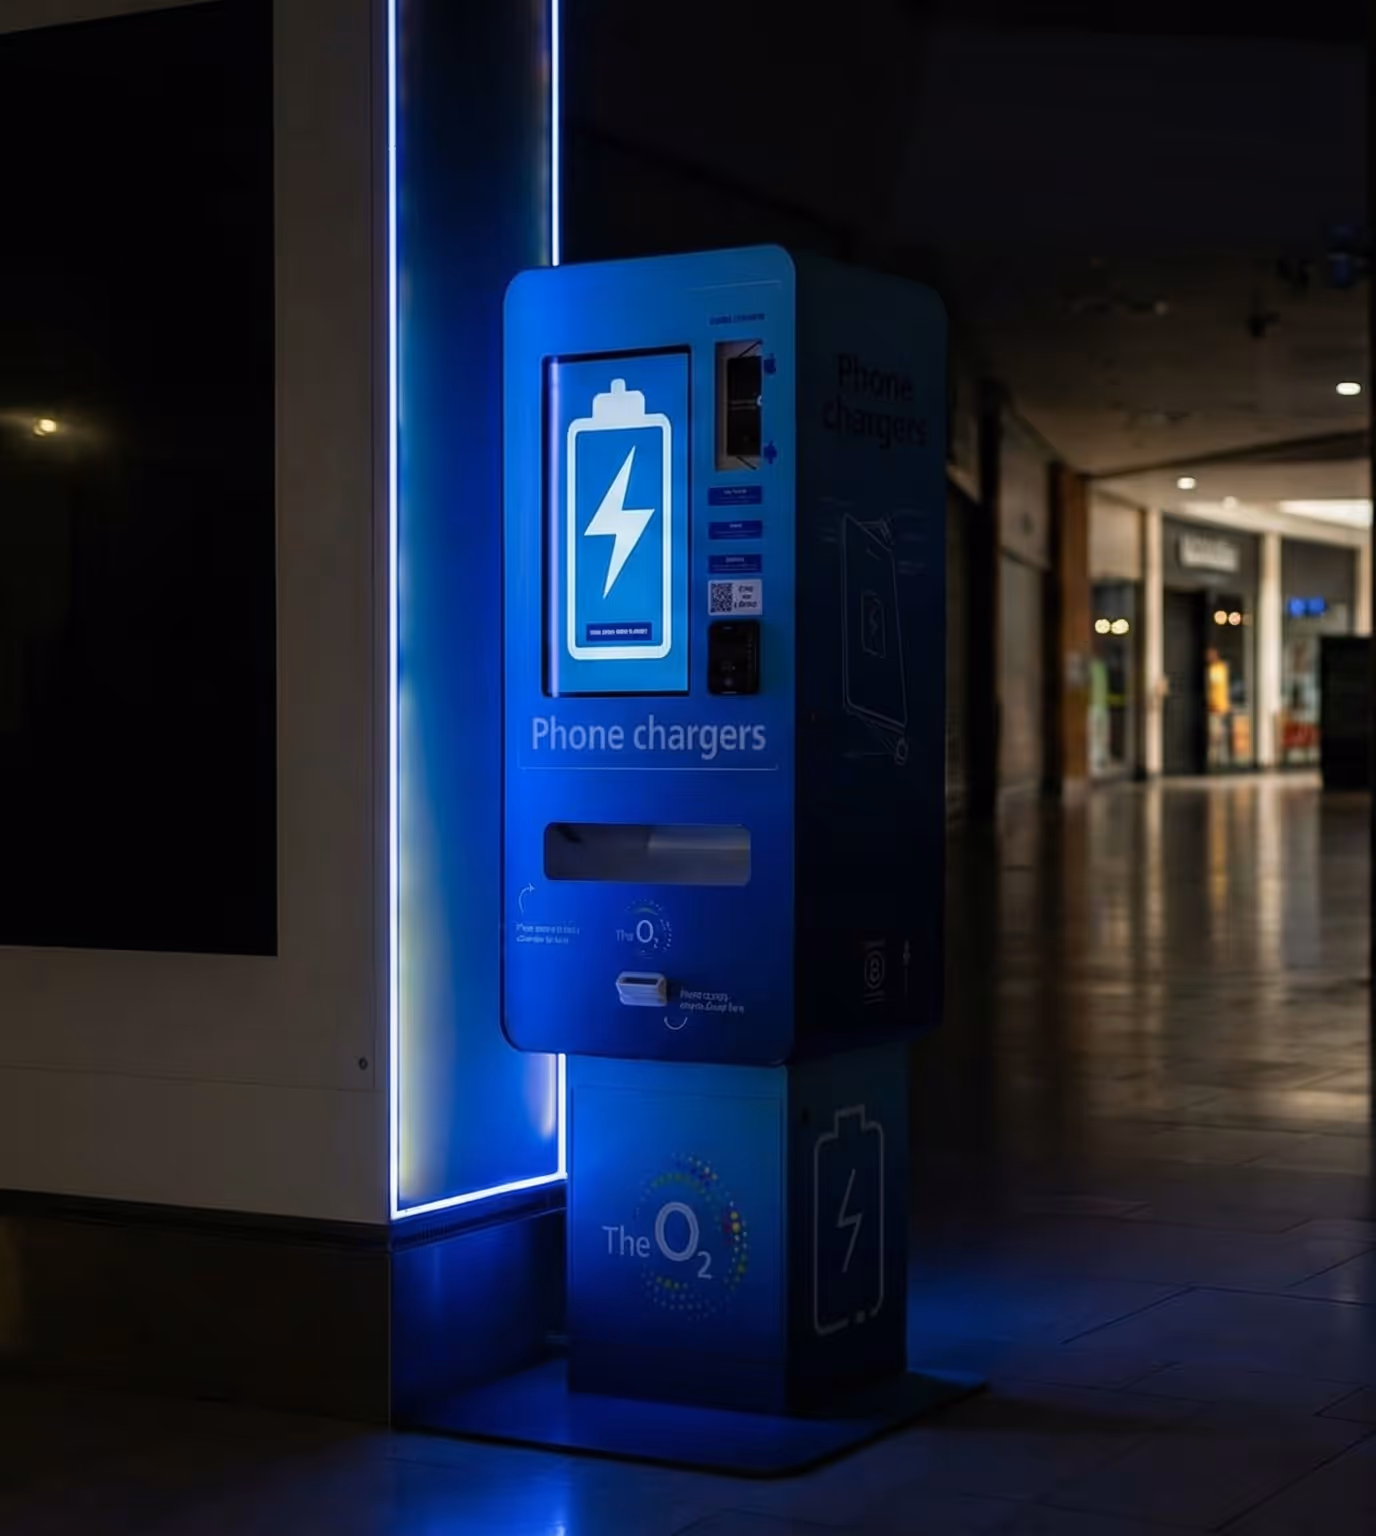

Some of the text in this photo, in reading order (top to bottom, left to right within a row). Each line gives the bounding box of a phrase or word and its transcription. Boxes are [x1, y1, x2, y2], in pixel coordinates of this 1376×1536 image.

[837, 353, 912, 401] Phone
[822, 397, 928, 449] chargers
[531, 712, 767, 760] Phone chargers
[601, 1201, 713, 1280] The O2
